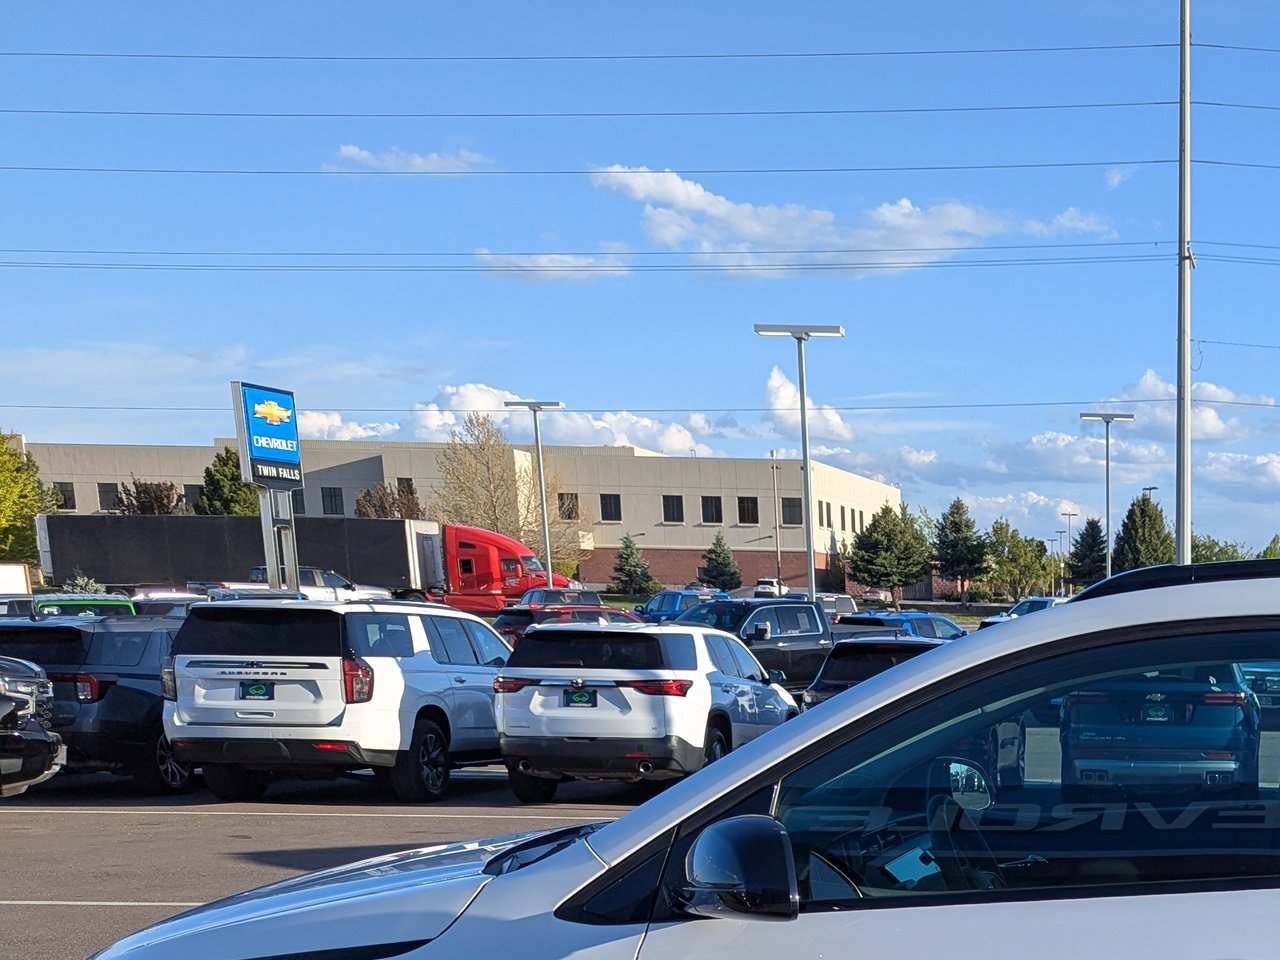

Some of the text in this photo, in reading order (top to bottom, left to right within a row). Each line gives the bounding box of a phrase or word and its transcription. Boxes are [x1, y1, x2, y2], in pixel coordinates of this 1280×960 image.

[254, 436, 297, 451] CHEVROLET
[257, 465, 299, 480] TWIN FALLS
